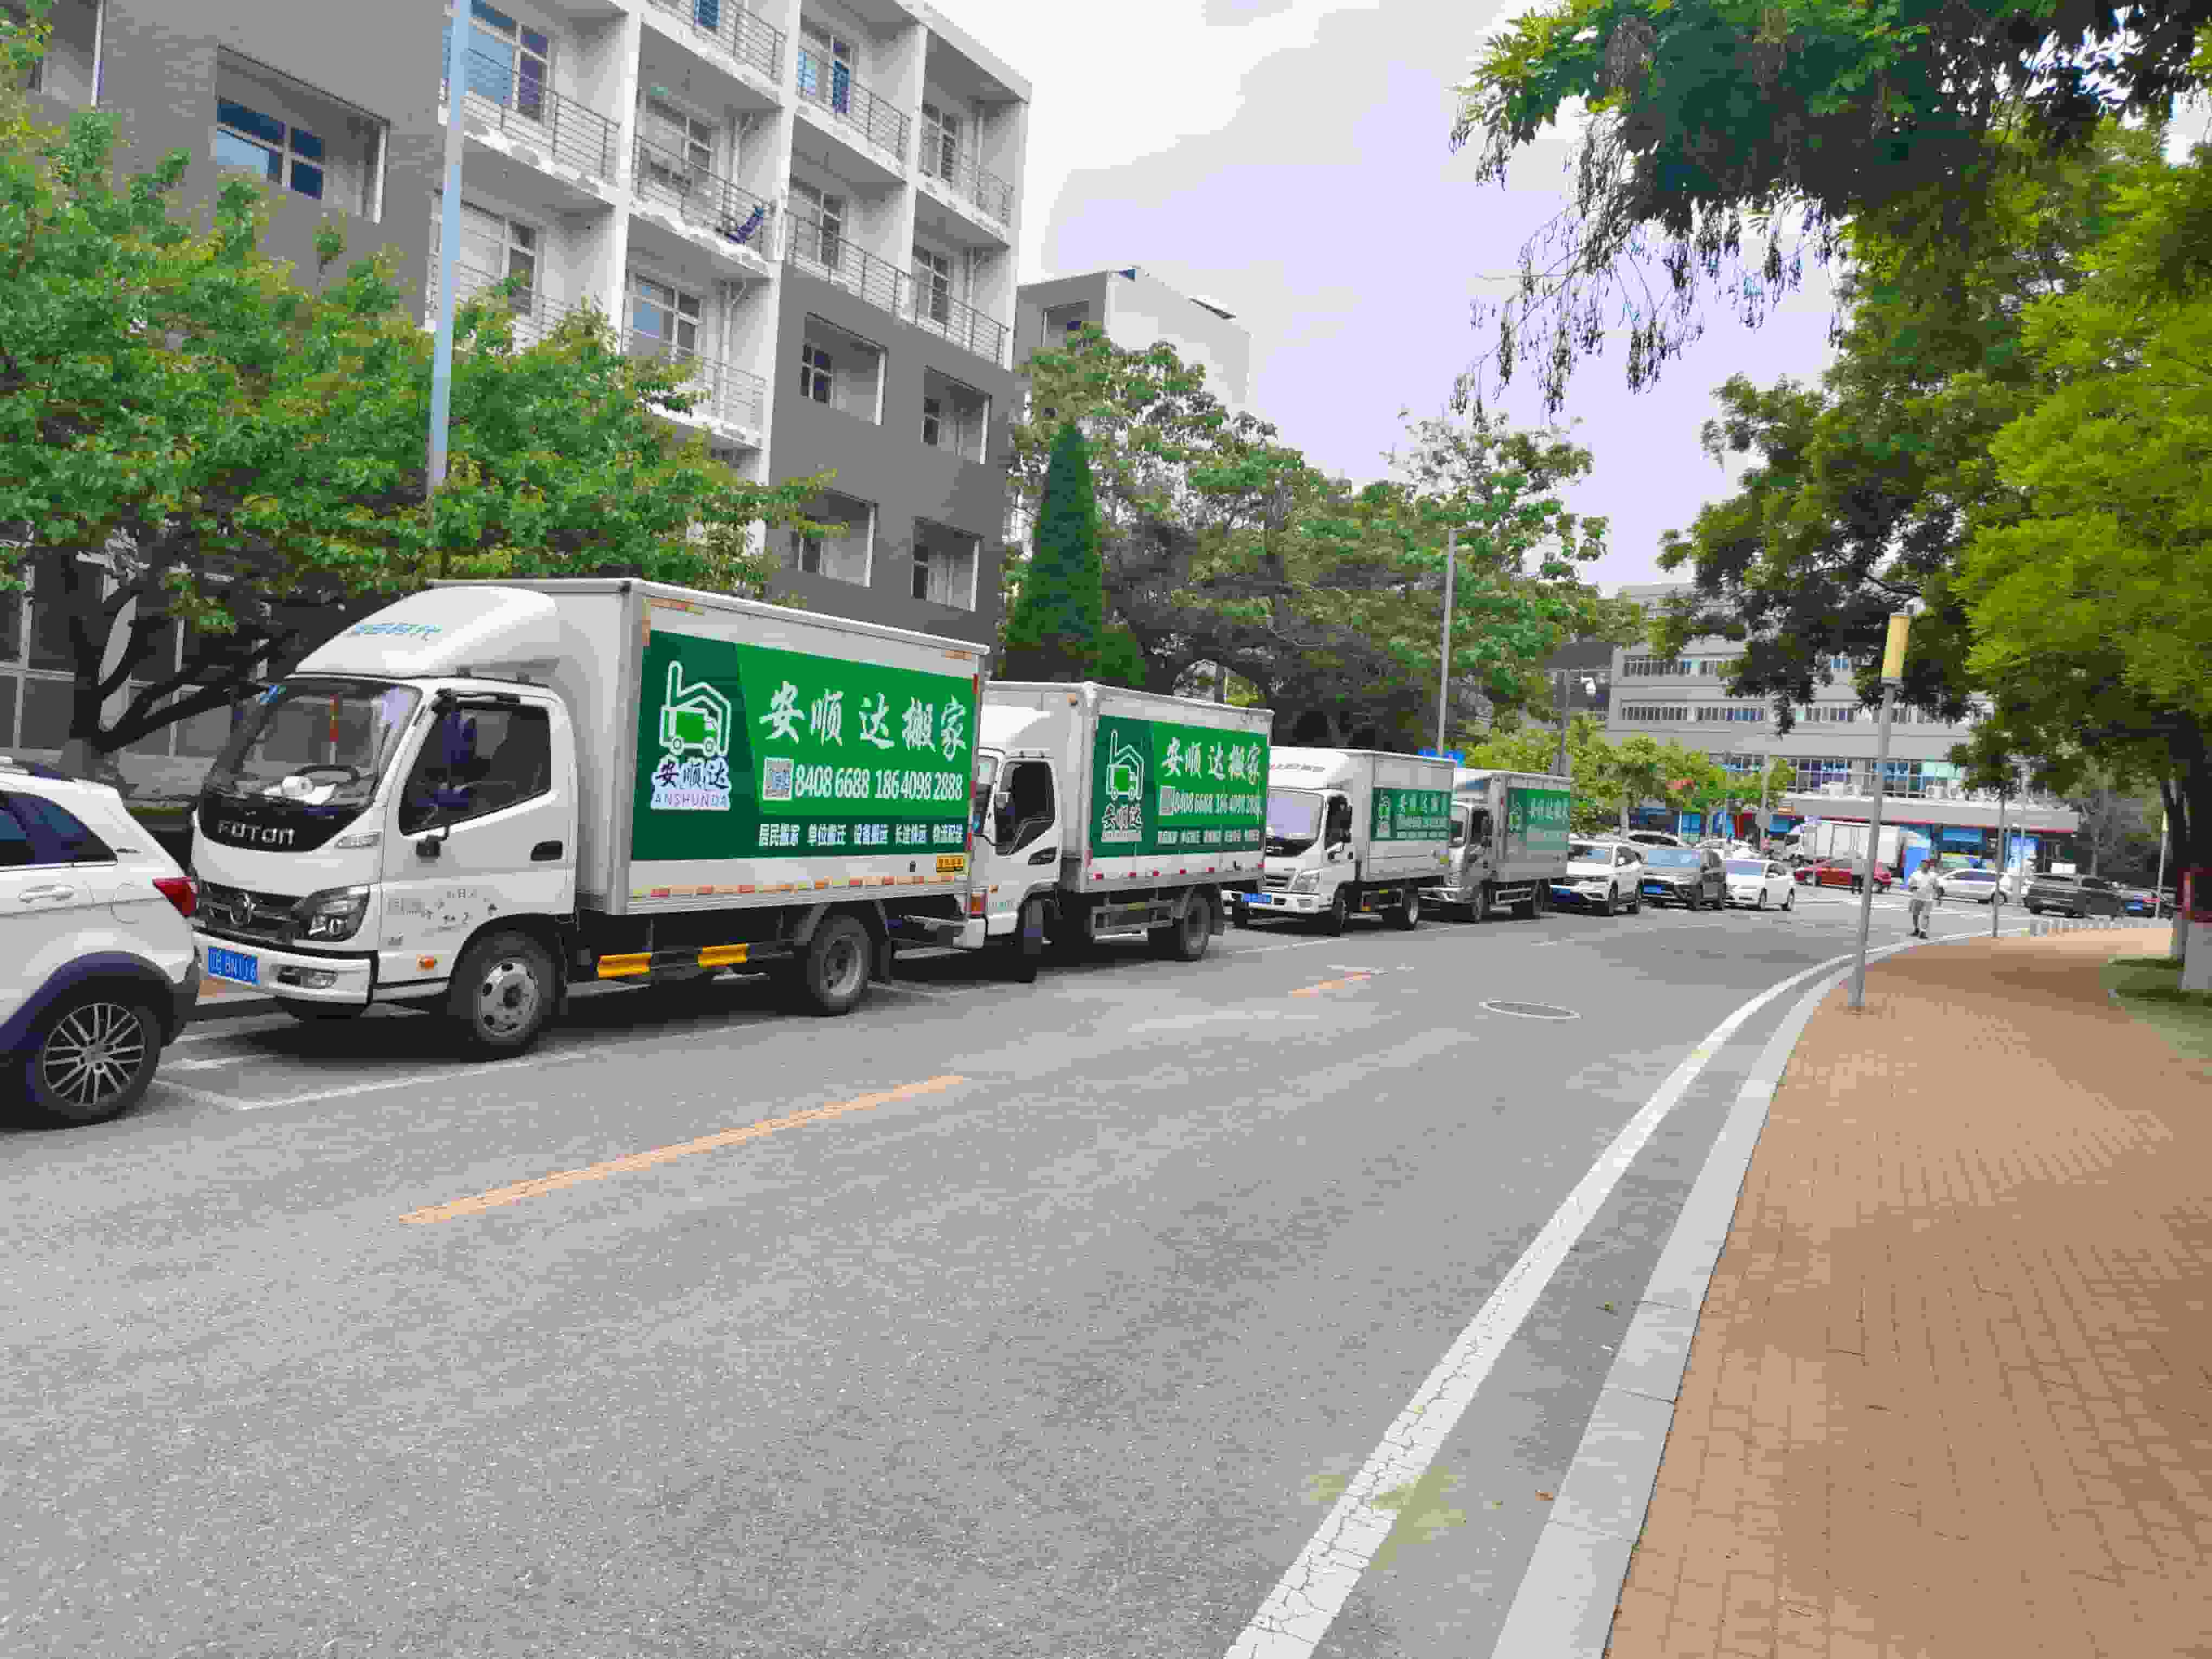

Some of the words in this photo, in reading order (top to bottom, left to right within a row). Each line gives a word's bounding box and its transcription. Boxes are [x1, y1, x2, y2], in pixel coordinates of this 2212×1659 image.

[760, 681, 967, 761] 安顺达搬家
[795, 763, 833, 798] 8408
[835, 767, 870, 799] 6688
